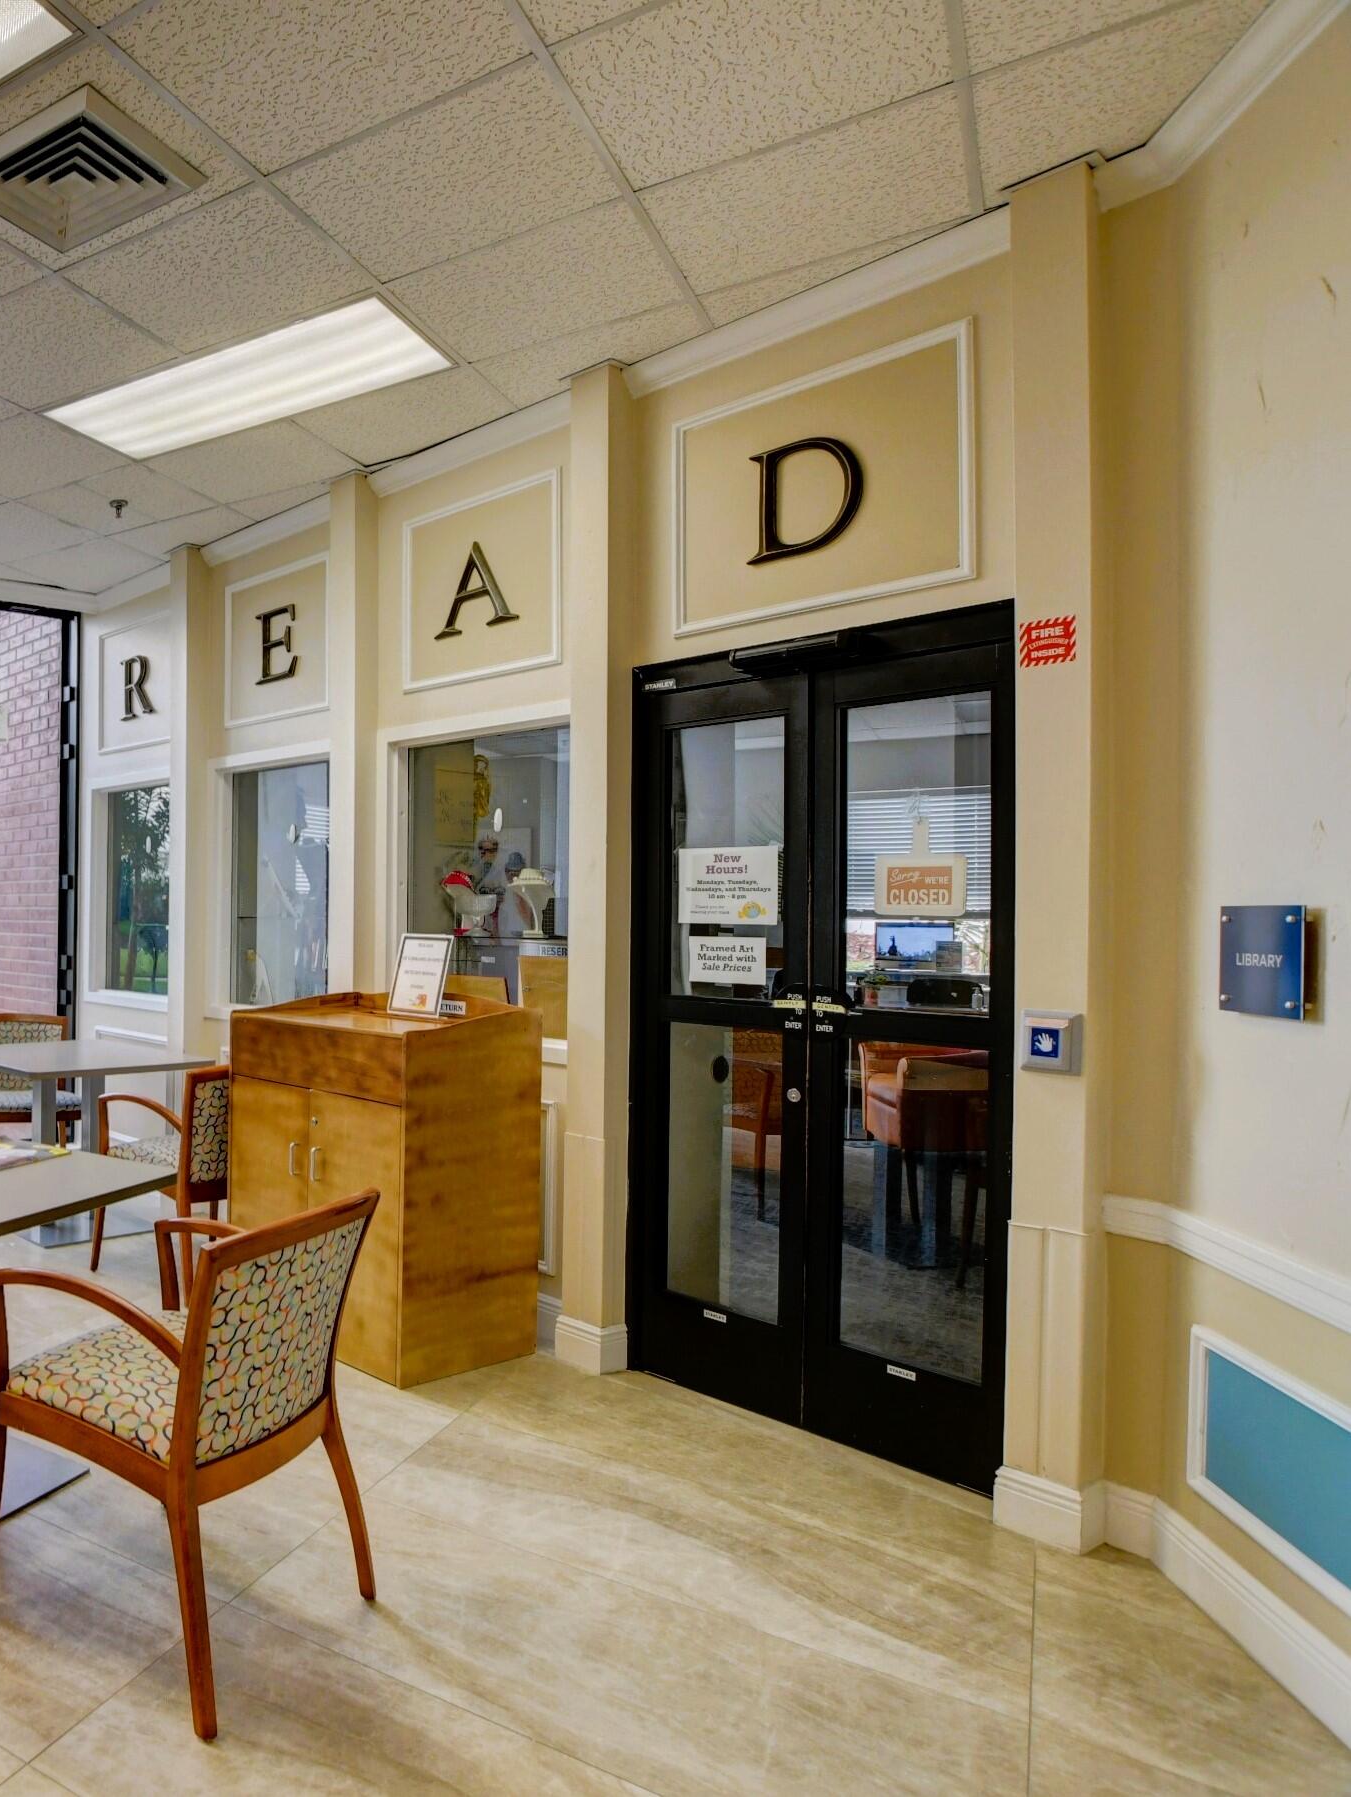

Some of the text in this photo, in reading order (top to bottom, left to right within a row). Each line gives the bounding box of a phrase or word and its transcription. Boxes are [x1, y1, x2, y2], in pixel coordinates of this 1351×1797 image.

[1031, 626, 1065, 640] FIRE
[1029, 638, 1069, 650] EXTINGUISHER
[1030, 647, 1065, 659] INSIDE
[644, 680, 674, 691] STANLEY
[713, 854, 742, 863] New
[705, 864, 748, 875] Hours!
[889, 868, 950, 885] Sorry WE'RE
[889, 888, 949, 905] CLOSED
[699, 943, 754, 953] Framed Art
[697, 953, 757, 963] Marked with
[1235, 952, 1283, 968] LIBRARY
[701, 962, 752, 972] Sale Prices
[440, 1003, 463, 1011] ETURN
[816, 1025, 834, 1033] ENTER
